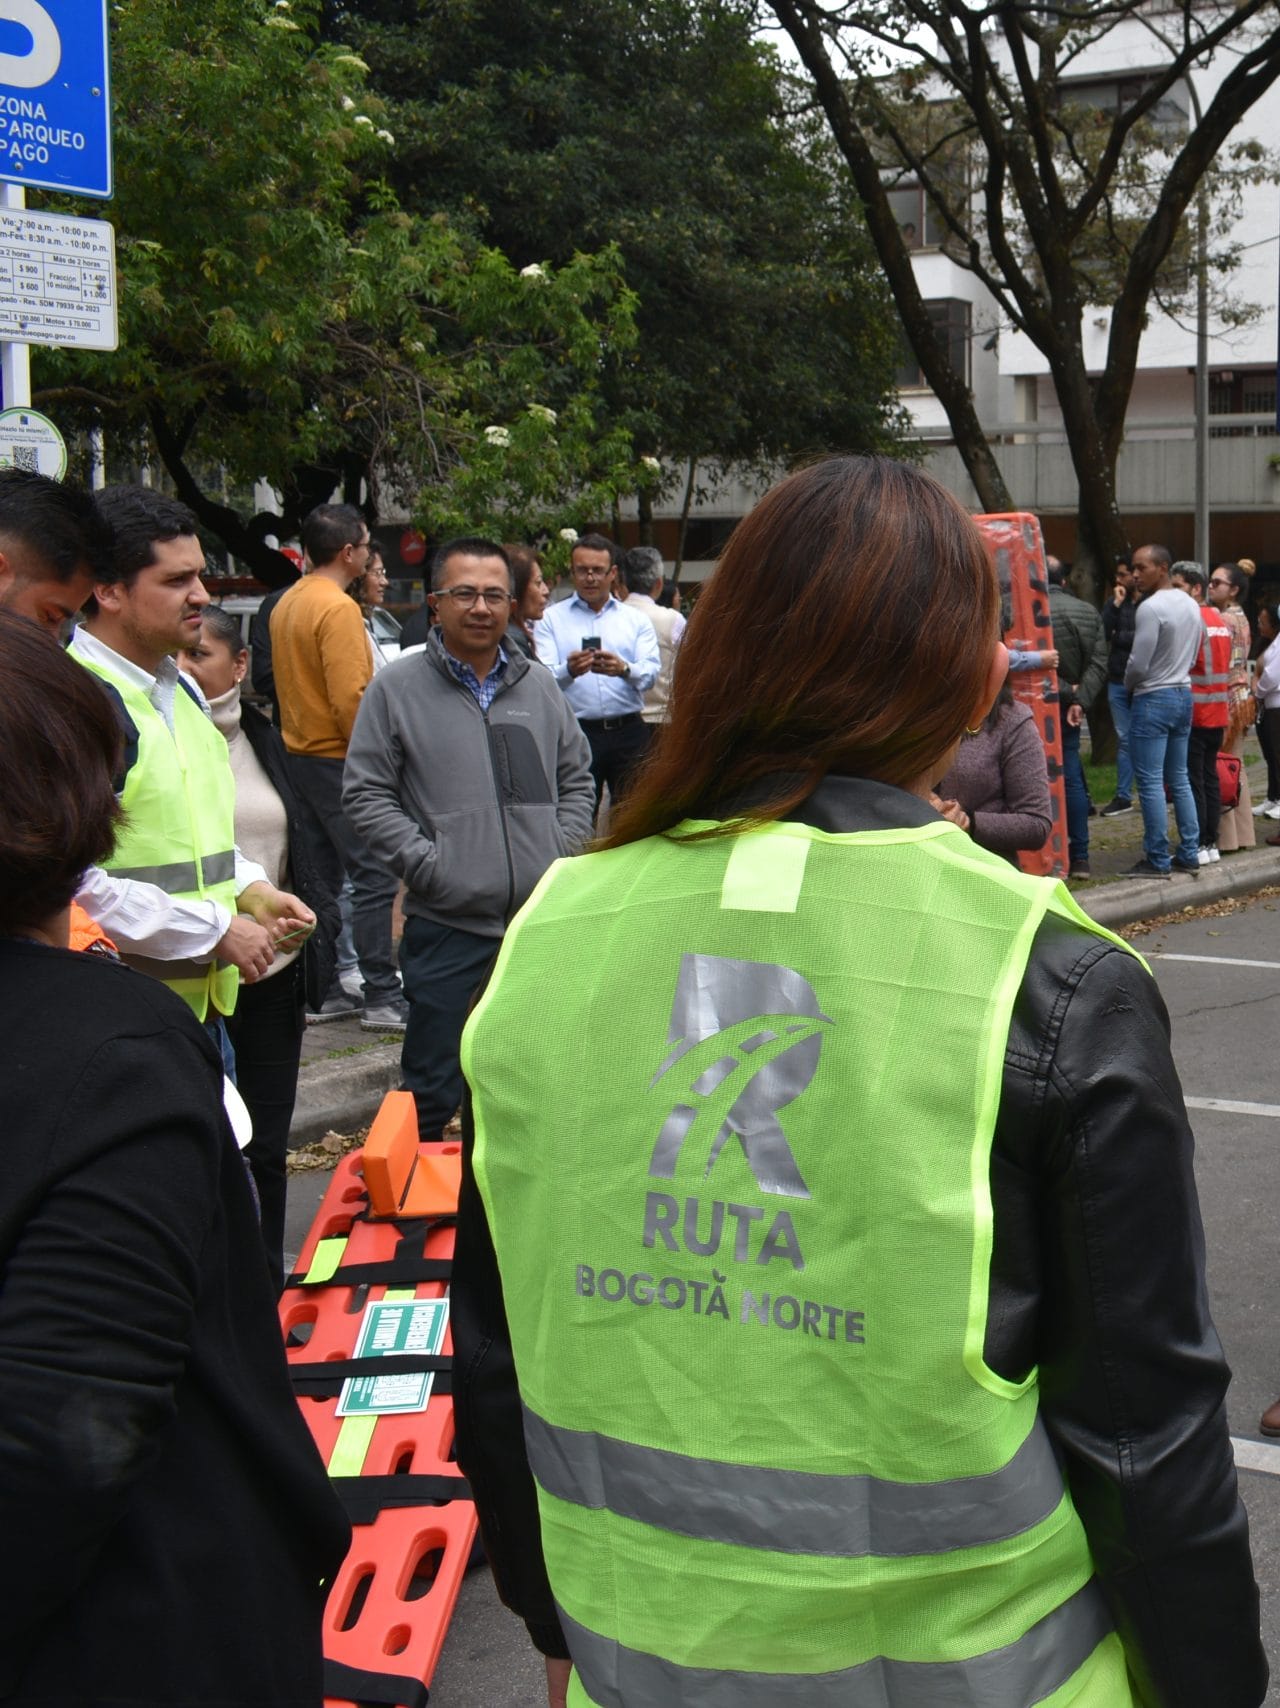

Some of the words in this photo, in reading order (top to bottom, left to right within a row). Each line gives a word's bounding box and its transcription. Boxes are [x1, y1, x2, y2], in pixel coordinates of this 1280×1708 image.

[0, 95, 47, 121] ZONA
[61, 226, 81, 236] 10:00
[83, 230, 99, 239] p.m.
[70, 240, 91, 250] 10:00
[92, 244, 109, 253] p.m.
[83, 260, 101, 269] horas
[643, 1191, 806, 1271] RUTA
[740, 1290, 866, 1344] NORTE
